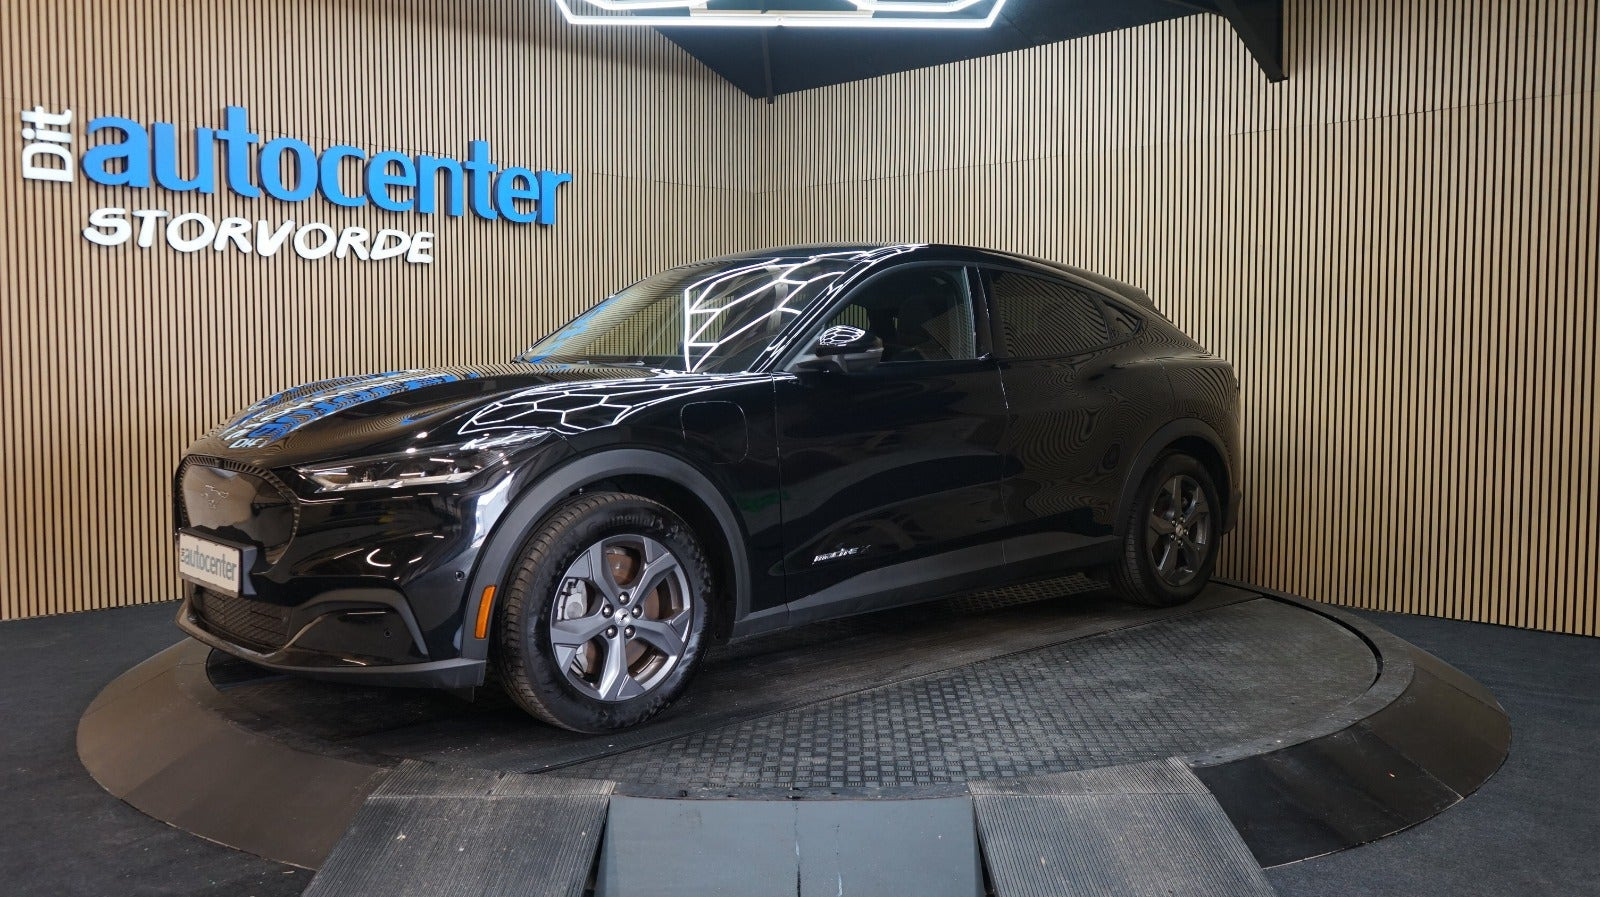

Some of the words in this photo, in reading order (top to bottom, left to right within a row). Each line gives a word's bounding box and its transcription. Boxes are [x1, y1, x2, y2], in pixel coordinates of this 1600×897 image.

[21, 105, 74, 183] Dit
[81, 105, 573, 226] autocenter
[82, 207, 435, 264] STORVORDE
[184, 545, 237, 581] autocenter
